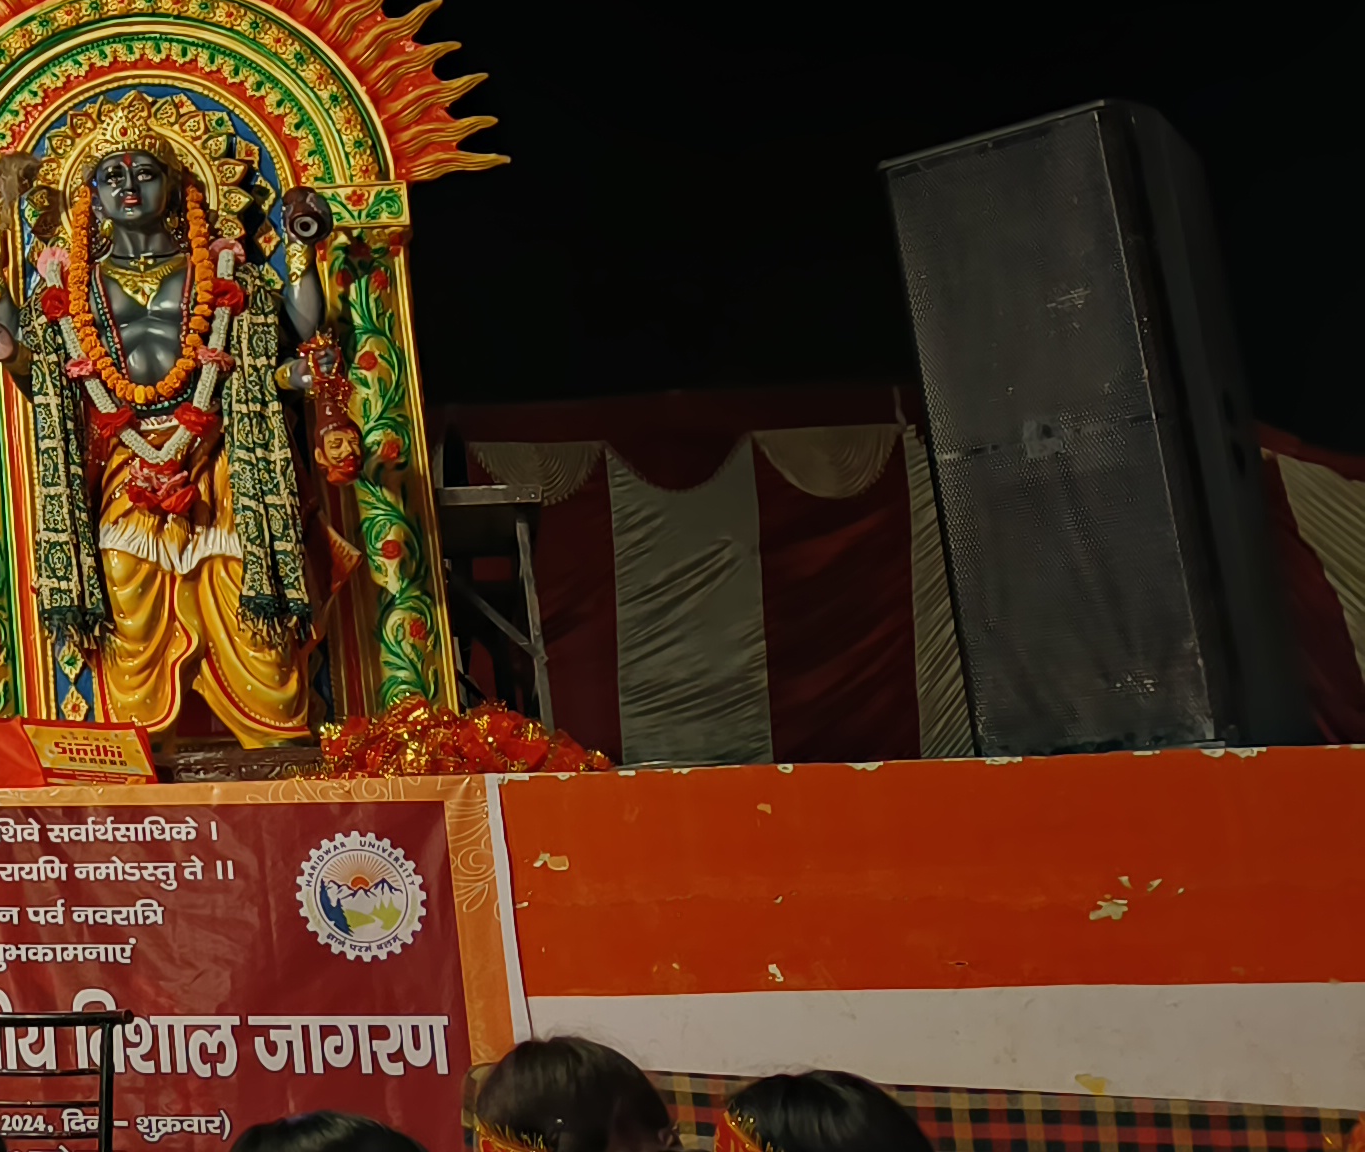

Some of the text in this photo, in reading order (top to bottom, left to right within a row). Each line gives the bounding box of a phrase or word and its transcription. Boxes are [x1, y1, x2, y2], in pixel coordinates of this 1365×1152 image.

[54, 741, 123, 759] Sindhi
[46, 816, 198, 843] सर्वार्थसाधिके
[182, 855, 204, 881] ते
[305, 839, 416, 888] HARIDWAR UNIVERSITY
[26, 899, 66, 925] पर्व
[71, 899, 164, 925] नवरात्रि
[247, 1015, 450, 1076] जागरण
[0, 1114, 54, 1133] 2024,
